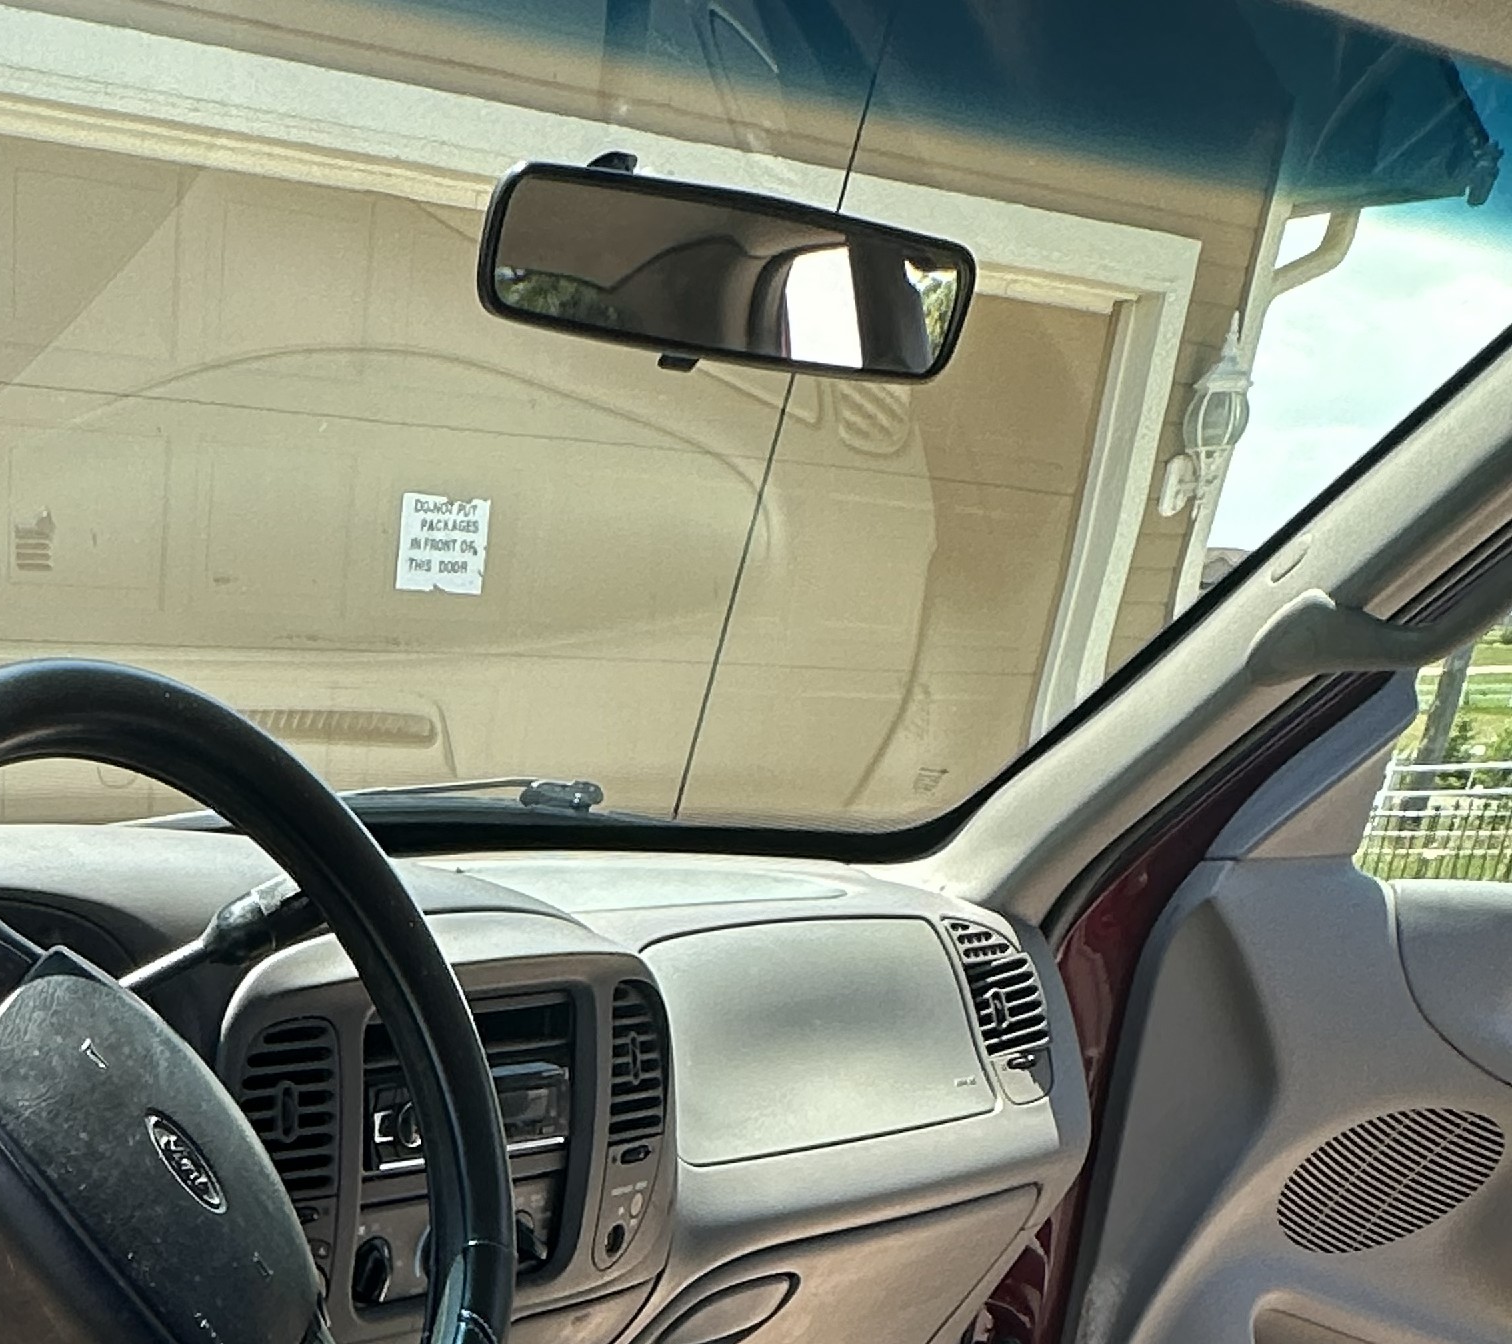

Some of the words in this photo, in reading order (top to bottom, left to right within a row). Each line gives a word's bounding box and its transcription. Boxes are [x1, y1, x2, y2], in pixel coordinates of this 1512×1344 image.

[457, 504, 478, 517] PUT
[420, 517, 479, 533] PACKAGES
[410, 537, 421, 550] IN
[424, 537, 457, 551] FRONT
[408, 557, 432, 572] THIS
[439, 561, 468, 574] DOOR
